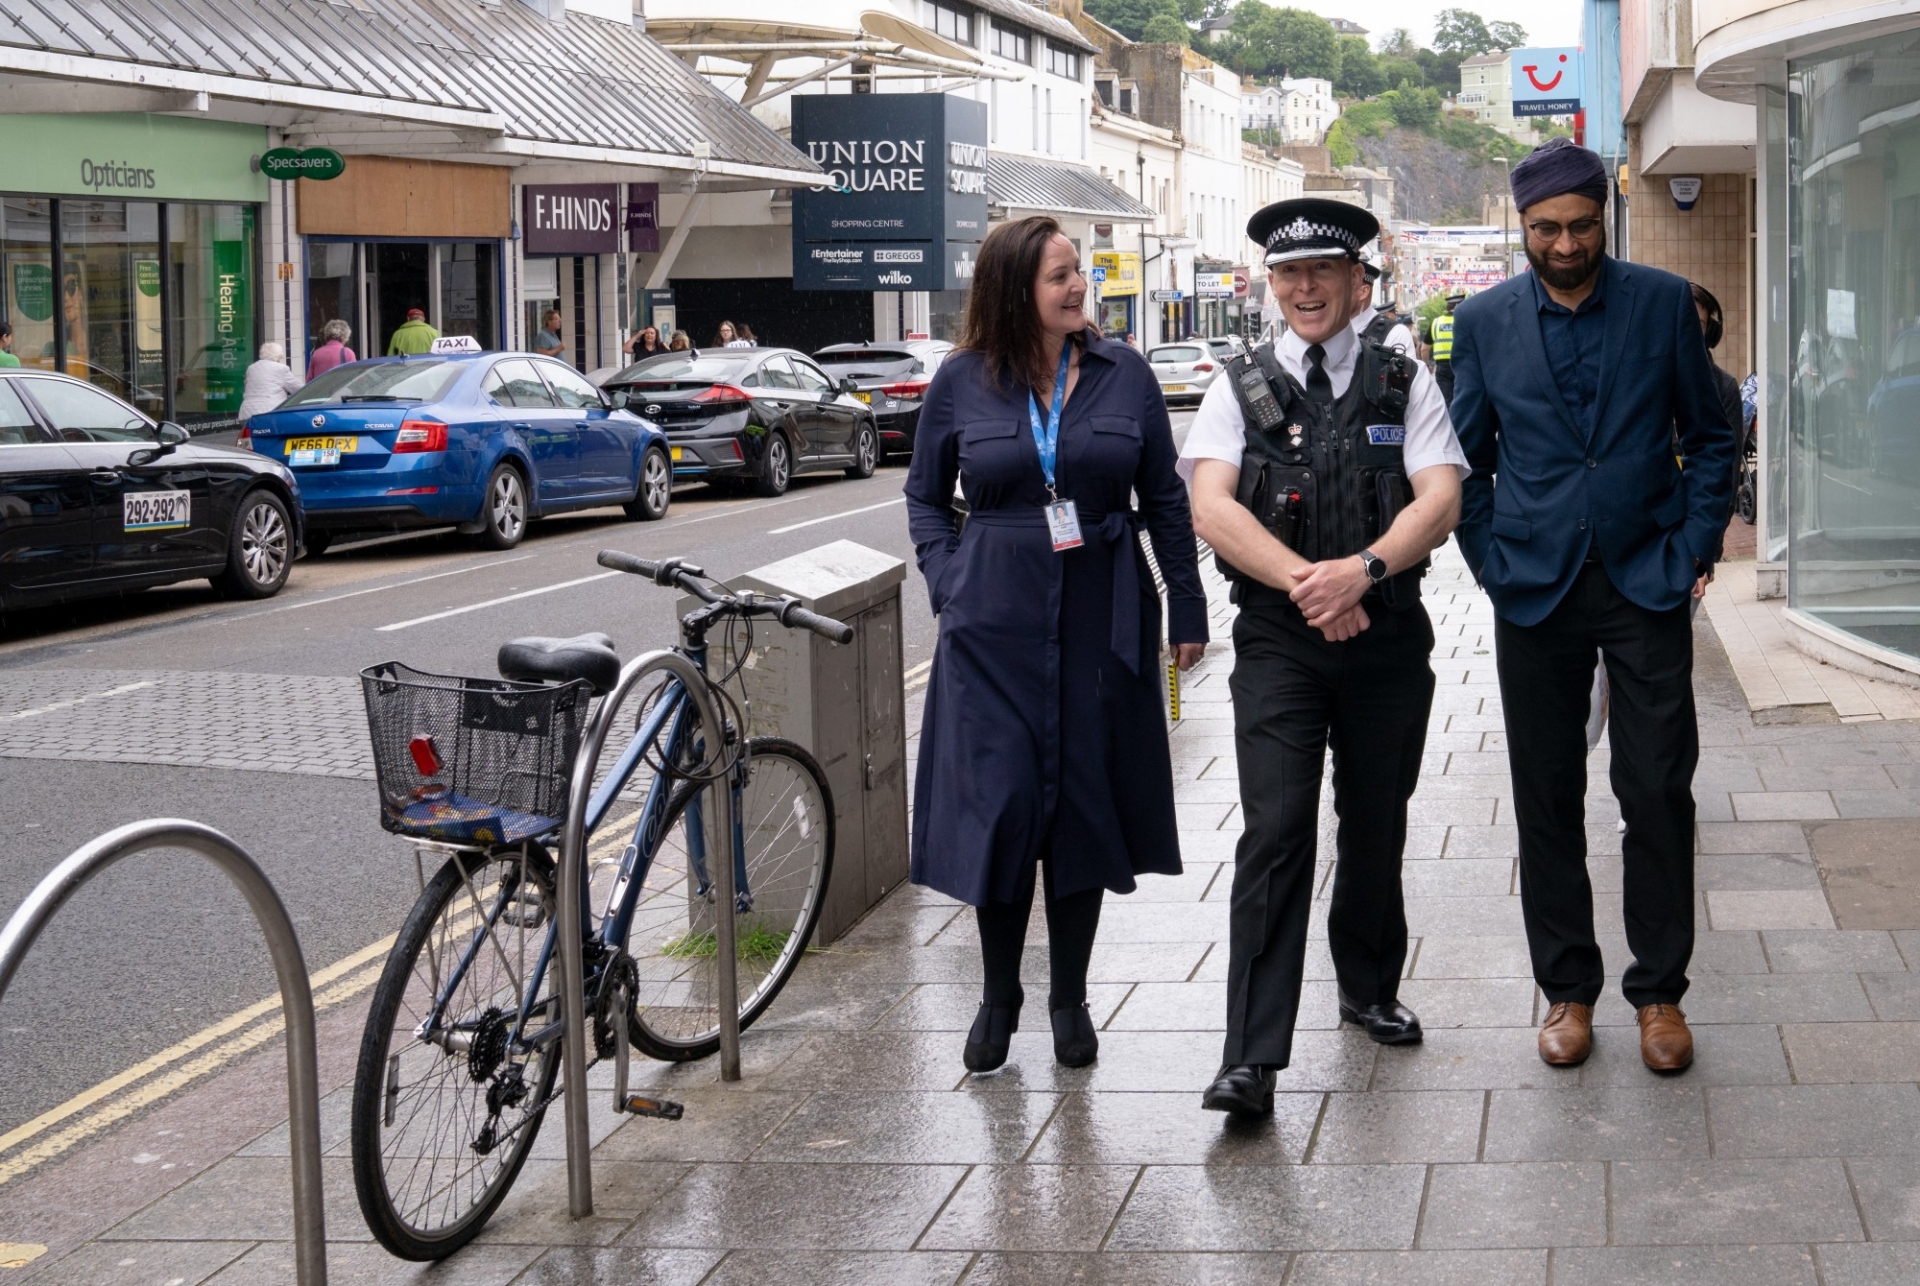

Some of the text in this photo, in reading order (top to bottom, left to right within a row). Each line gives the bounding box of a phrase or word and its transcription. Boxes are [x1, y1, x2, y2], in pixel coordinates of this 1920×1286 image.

[1520, 102, 1574, 112] TRAVEL MONEY
[807, 140, 925, 165] UNION
[950, 141, 987, 169] UNION
[267, 156, 332, 171] Specsavers
[81, 157, 156, 192] Opticians
[950, 169, 987, 195] SQUARE
[535, 194, 611, 232] F.HINDS
[831, 220, 904, 228] SHOPPING CENTRE
[1447, 236, 1461, 244] Day
[816, 249, 864, 258] Entertainer
[885, 252, 921, 260] GREGGS
[878, 270, 912, 284] wilko
[217, 274, 237, 368] Hearing Aids
[436, 338, 468, 349] TAXI
[211, 420, 236, 429] prescription
[1371, 427, 1405, 441] POLICE
